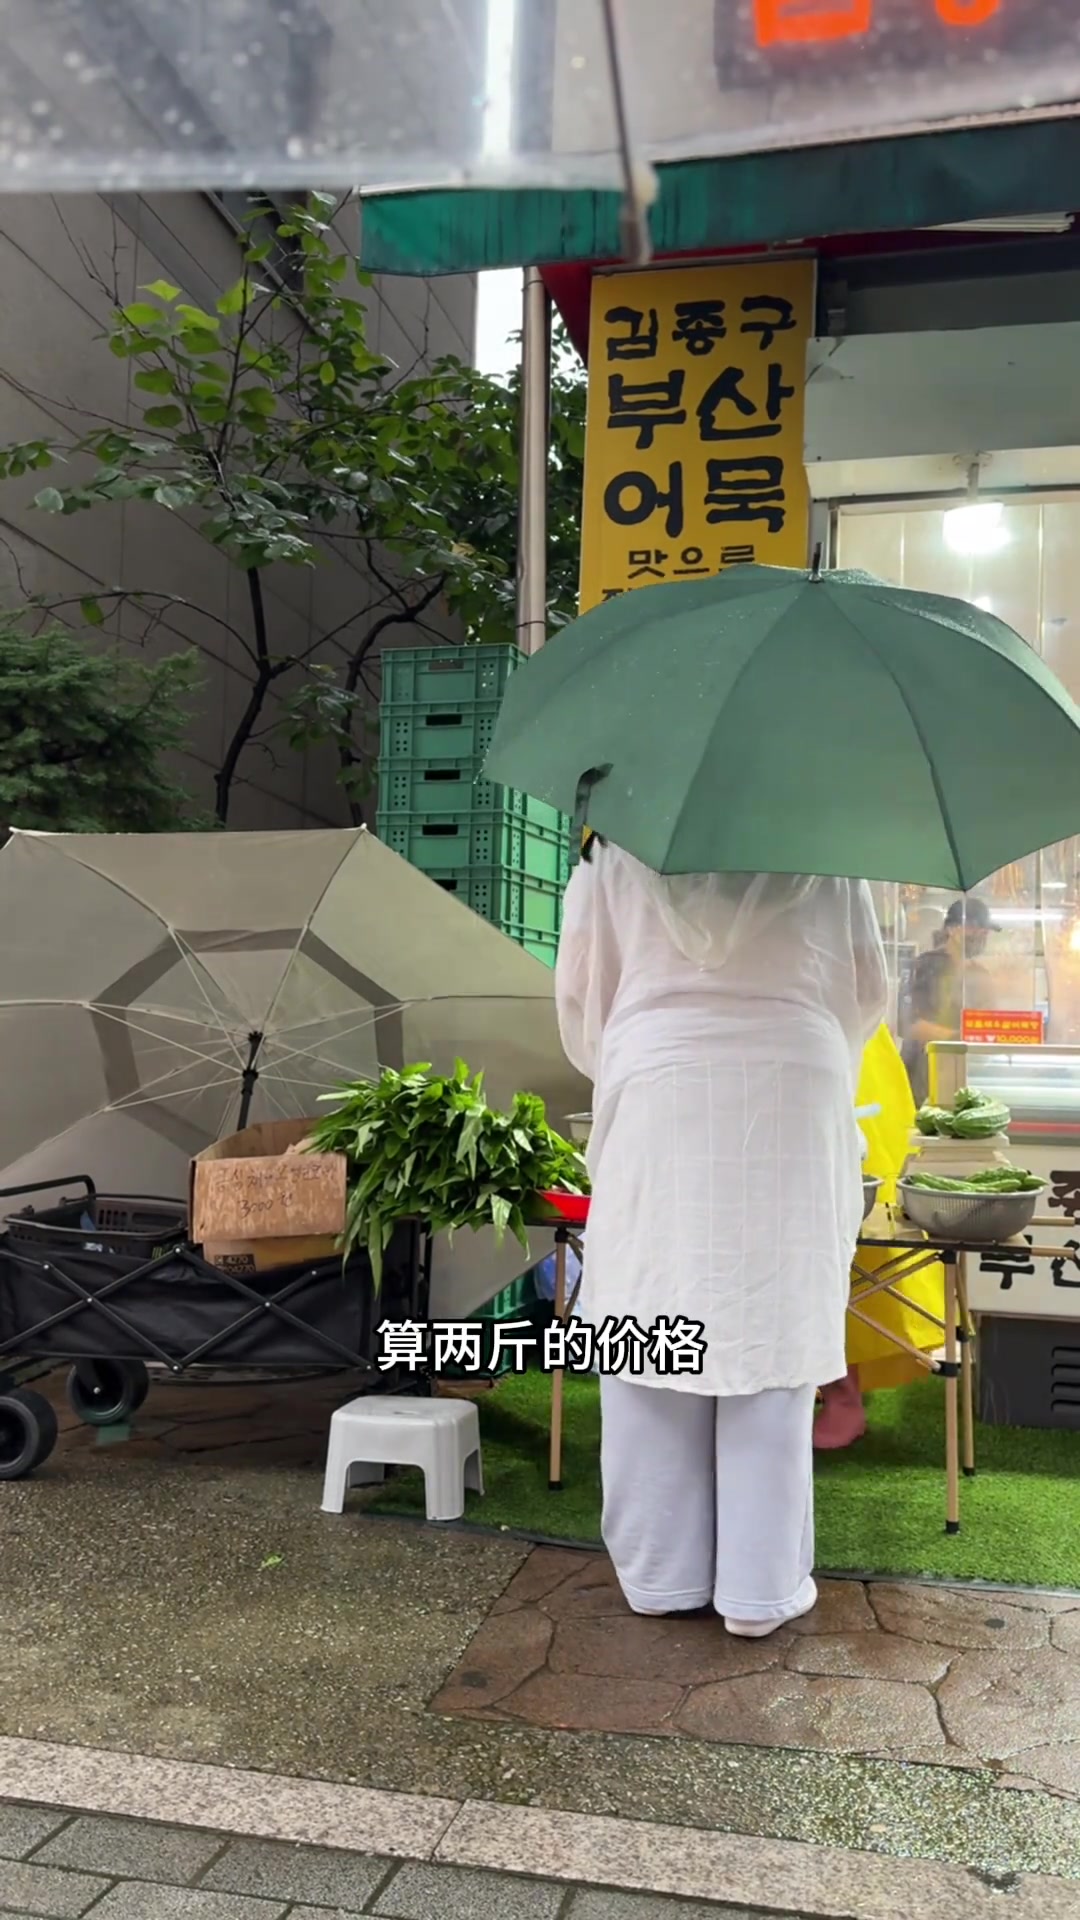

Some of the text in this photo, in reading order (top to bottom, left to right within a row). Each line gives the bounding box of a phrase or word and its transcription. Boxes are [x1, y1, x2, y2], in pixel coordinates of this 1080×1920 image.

[604, 295, 797, 361] 김종구
[607, 363, 795, 449] 부산
[603, 455, 786, 538] 어묵
